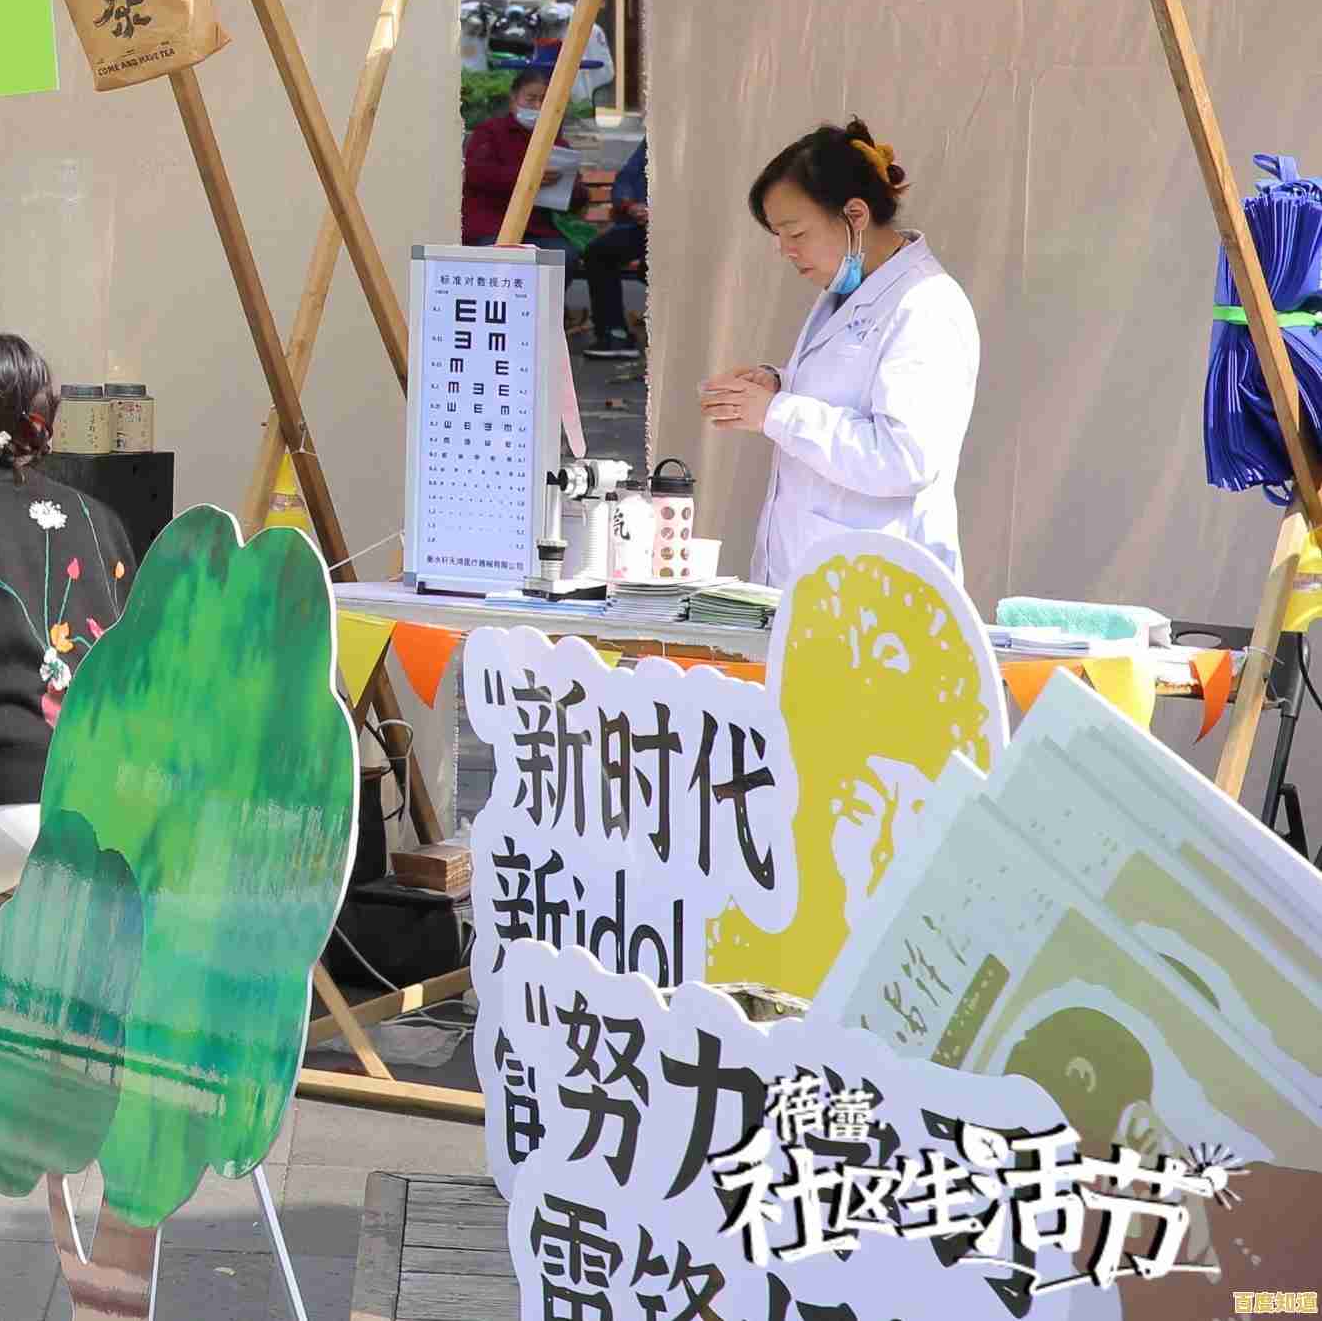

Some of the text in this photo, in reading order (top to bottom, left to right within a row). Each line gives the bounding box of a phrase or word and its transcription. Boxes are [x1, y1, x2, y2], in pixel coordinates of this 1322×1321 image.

[440, 274, 525, 289] 标准对数视力表
